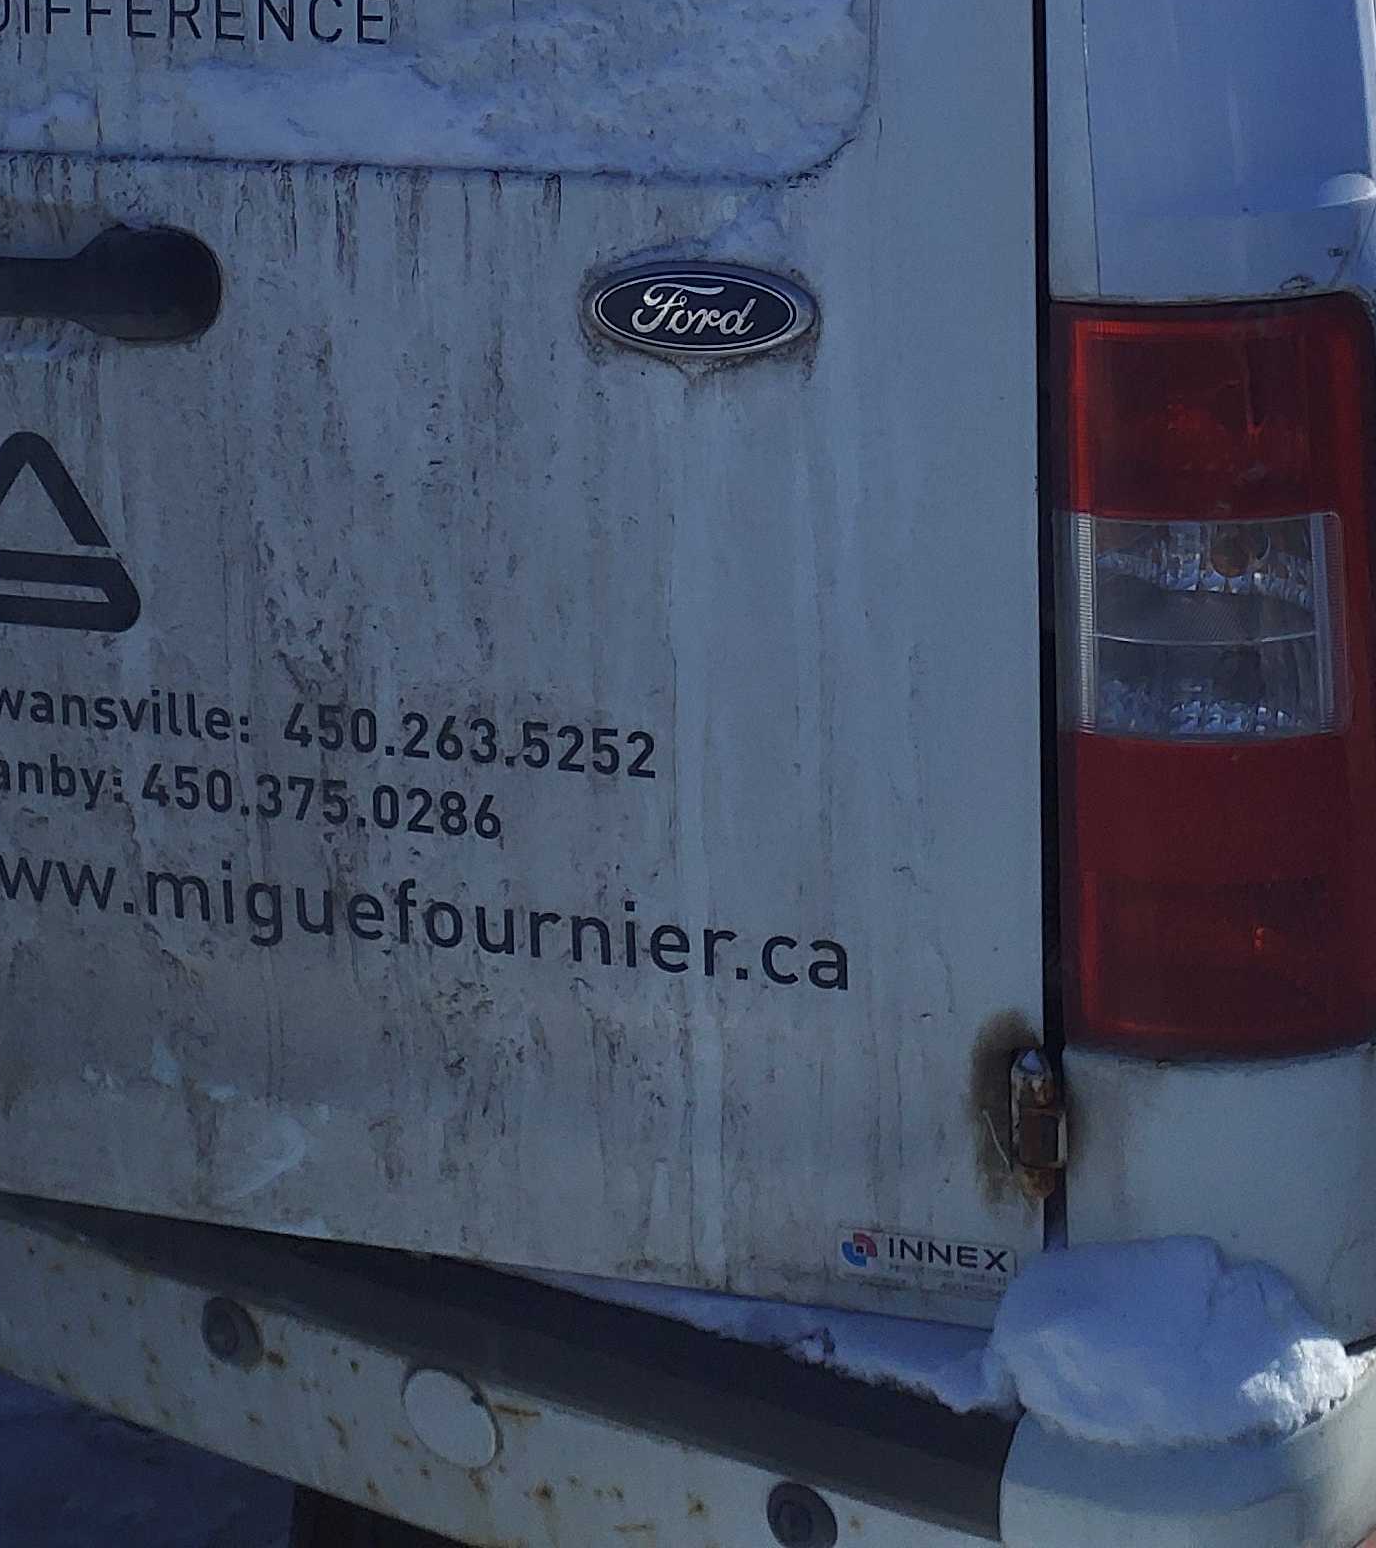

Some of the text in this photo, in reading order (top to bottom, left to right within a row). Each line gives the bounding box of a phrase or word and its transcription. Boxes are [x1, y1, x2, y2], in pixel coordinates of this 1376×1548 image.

[631, 282, 757, 335] Ford
[283, 703, 658, 780] 450.263.5252
[139, 762, 503, 839] 450.375.0286
[888, 1237, 1010, 1273] INNEX
